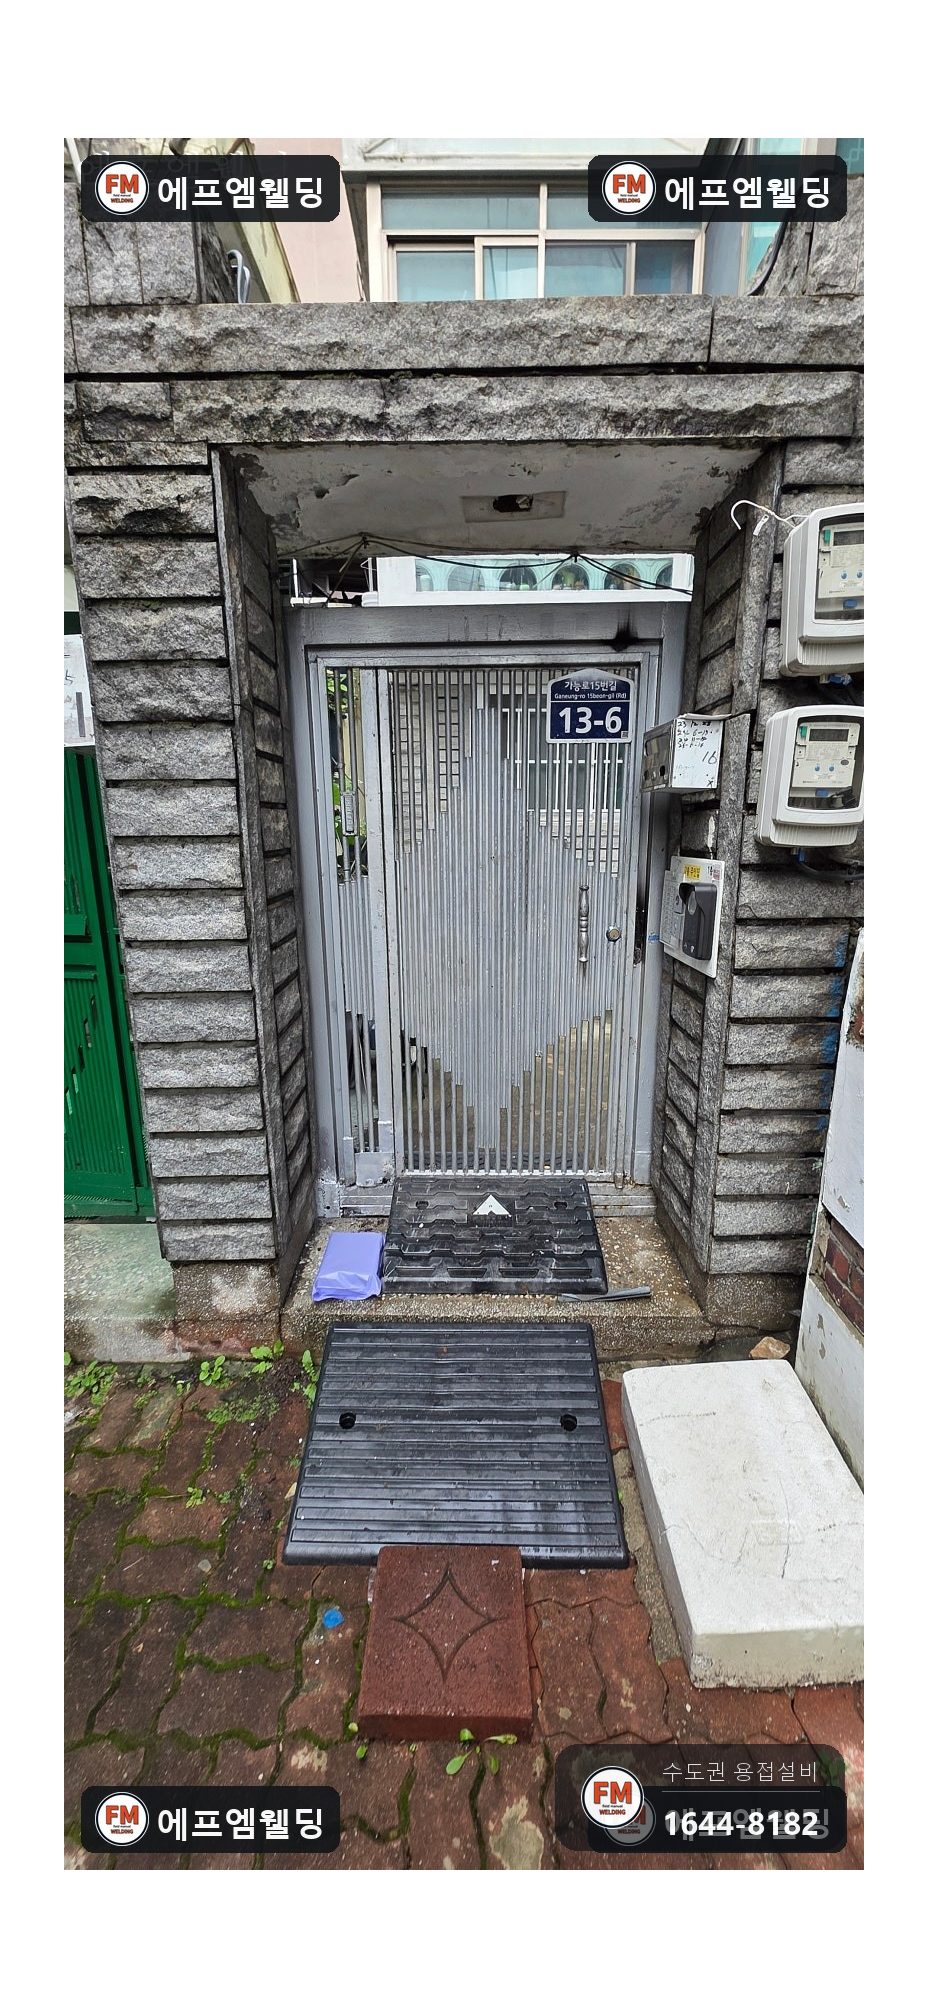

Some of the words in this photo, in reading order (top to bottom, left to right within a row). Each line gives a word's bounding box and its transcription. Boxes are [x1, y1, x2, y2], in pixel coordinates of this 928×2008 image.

[564, 680, 617, 692] 가능로15번길
[558, 706, 622, 734] 13-6
[702, 750, 718, 765] 16
